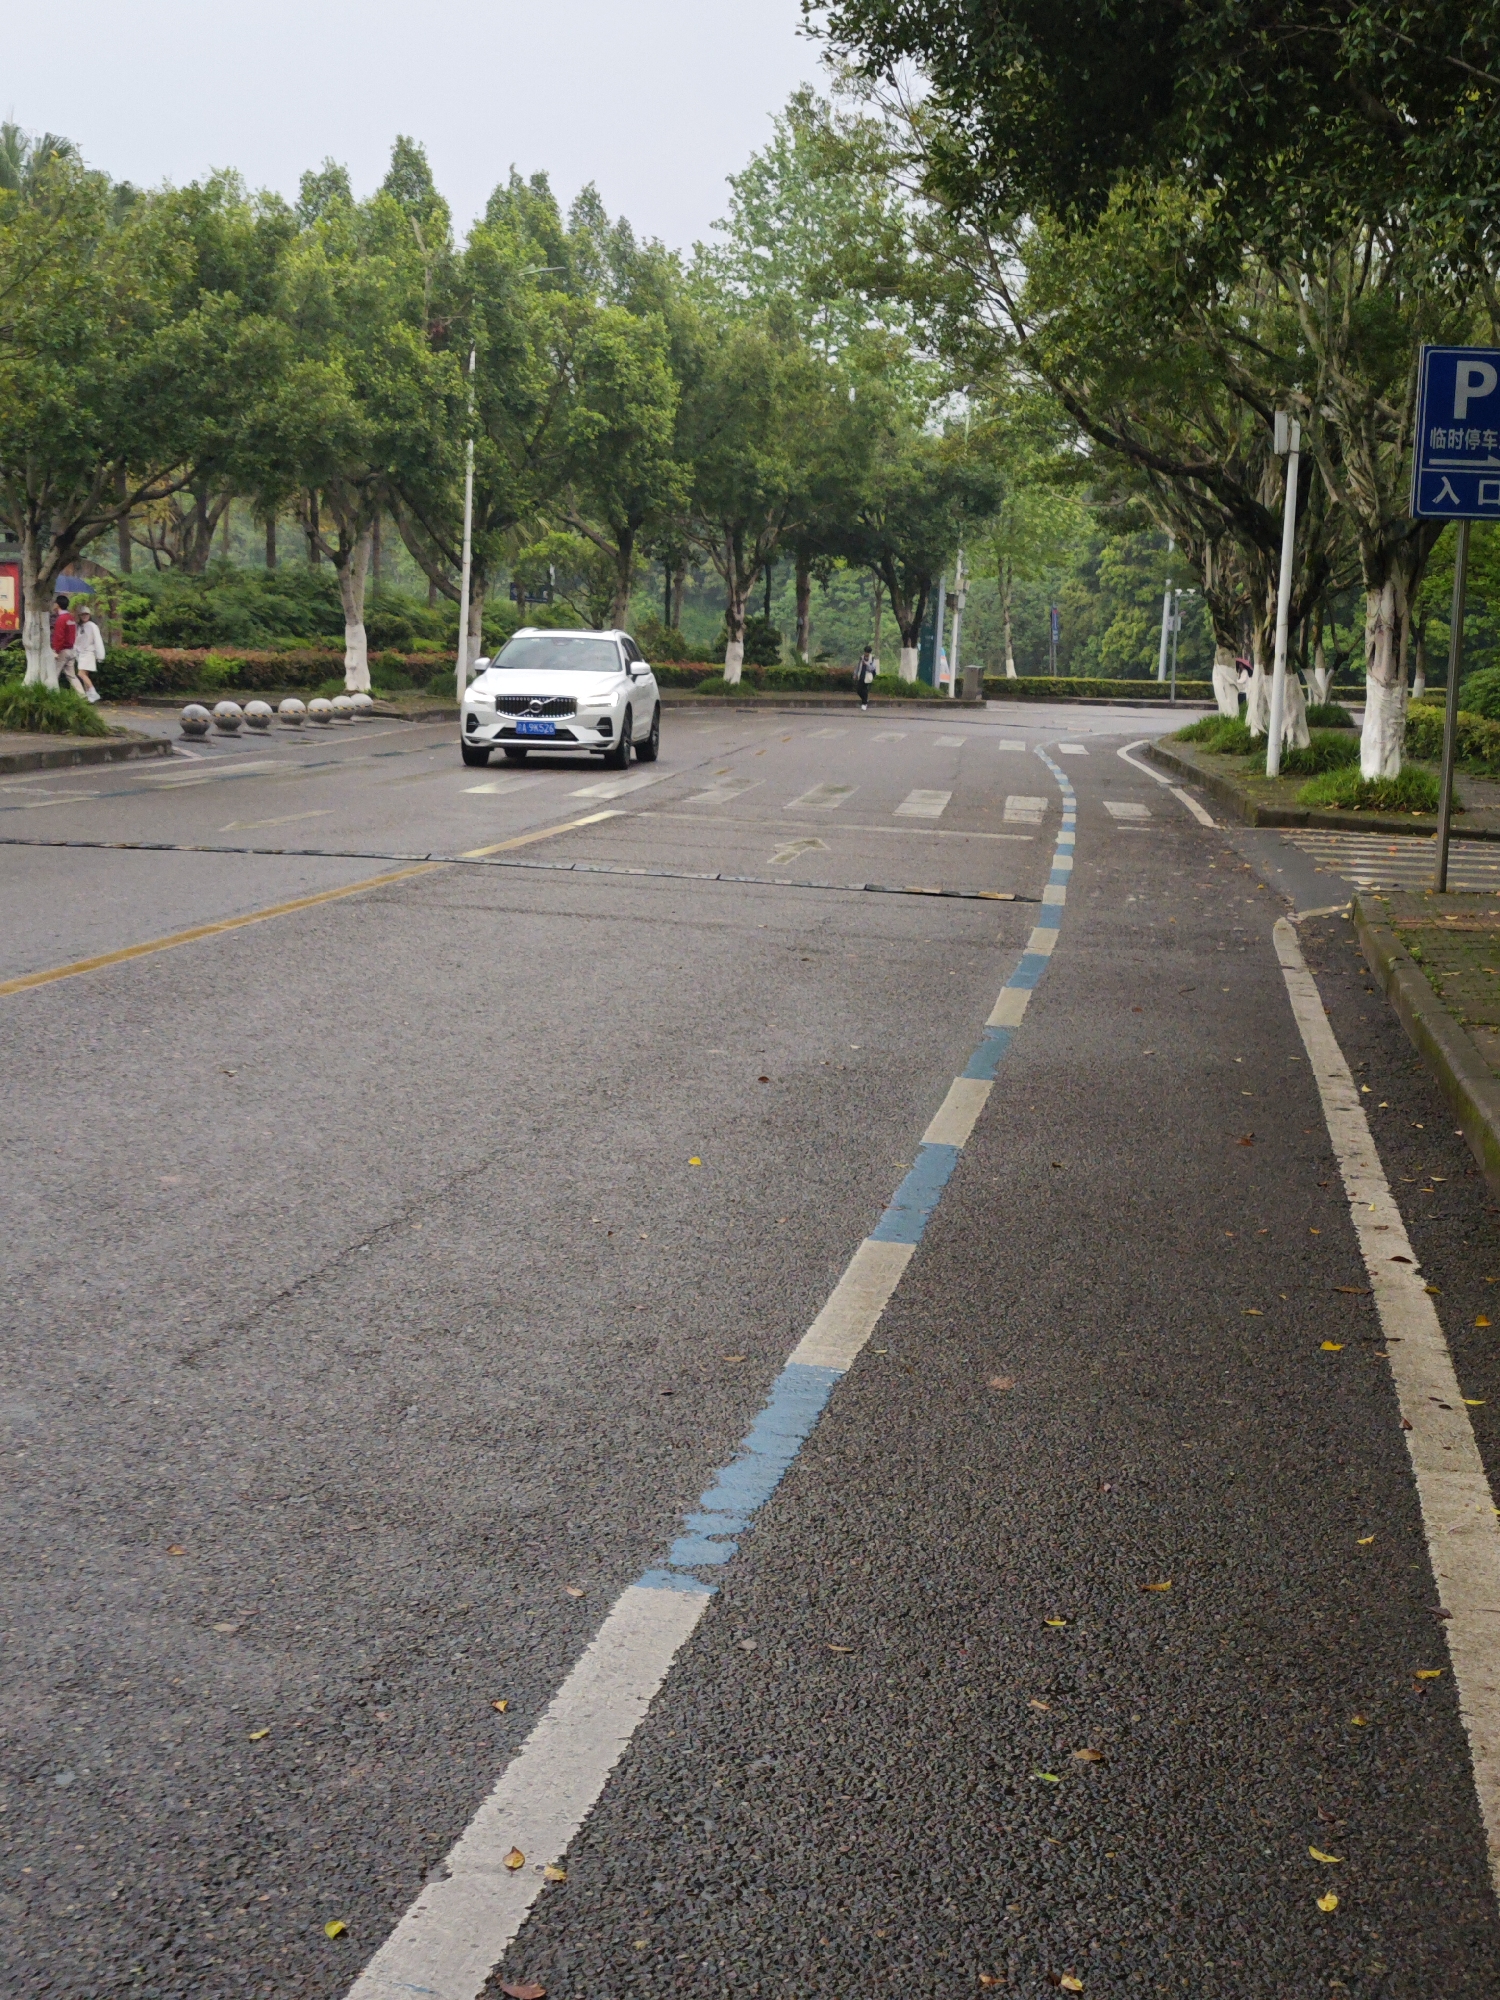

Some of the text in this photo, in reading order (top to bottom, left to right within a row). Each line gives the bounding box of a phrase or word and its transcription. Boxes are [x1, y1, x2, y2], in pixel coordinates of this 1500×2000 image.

[1453, 360, 1498, 420] P
[1429, 426, 1500, 450] 临时停车
[1431, 475, 1500, 506] 入口
